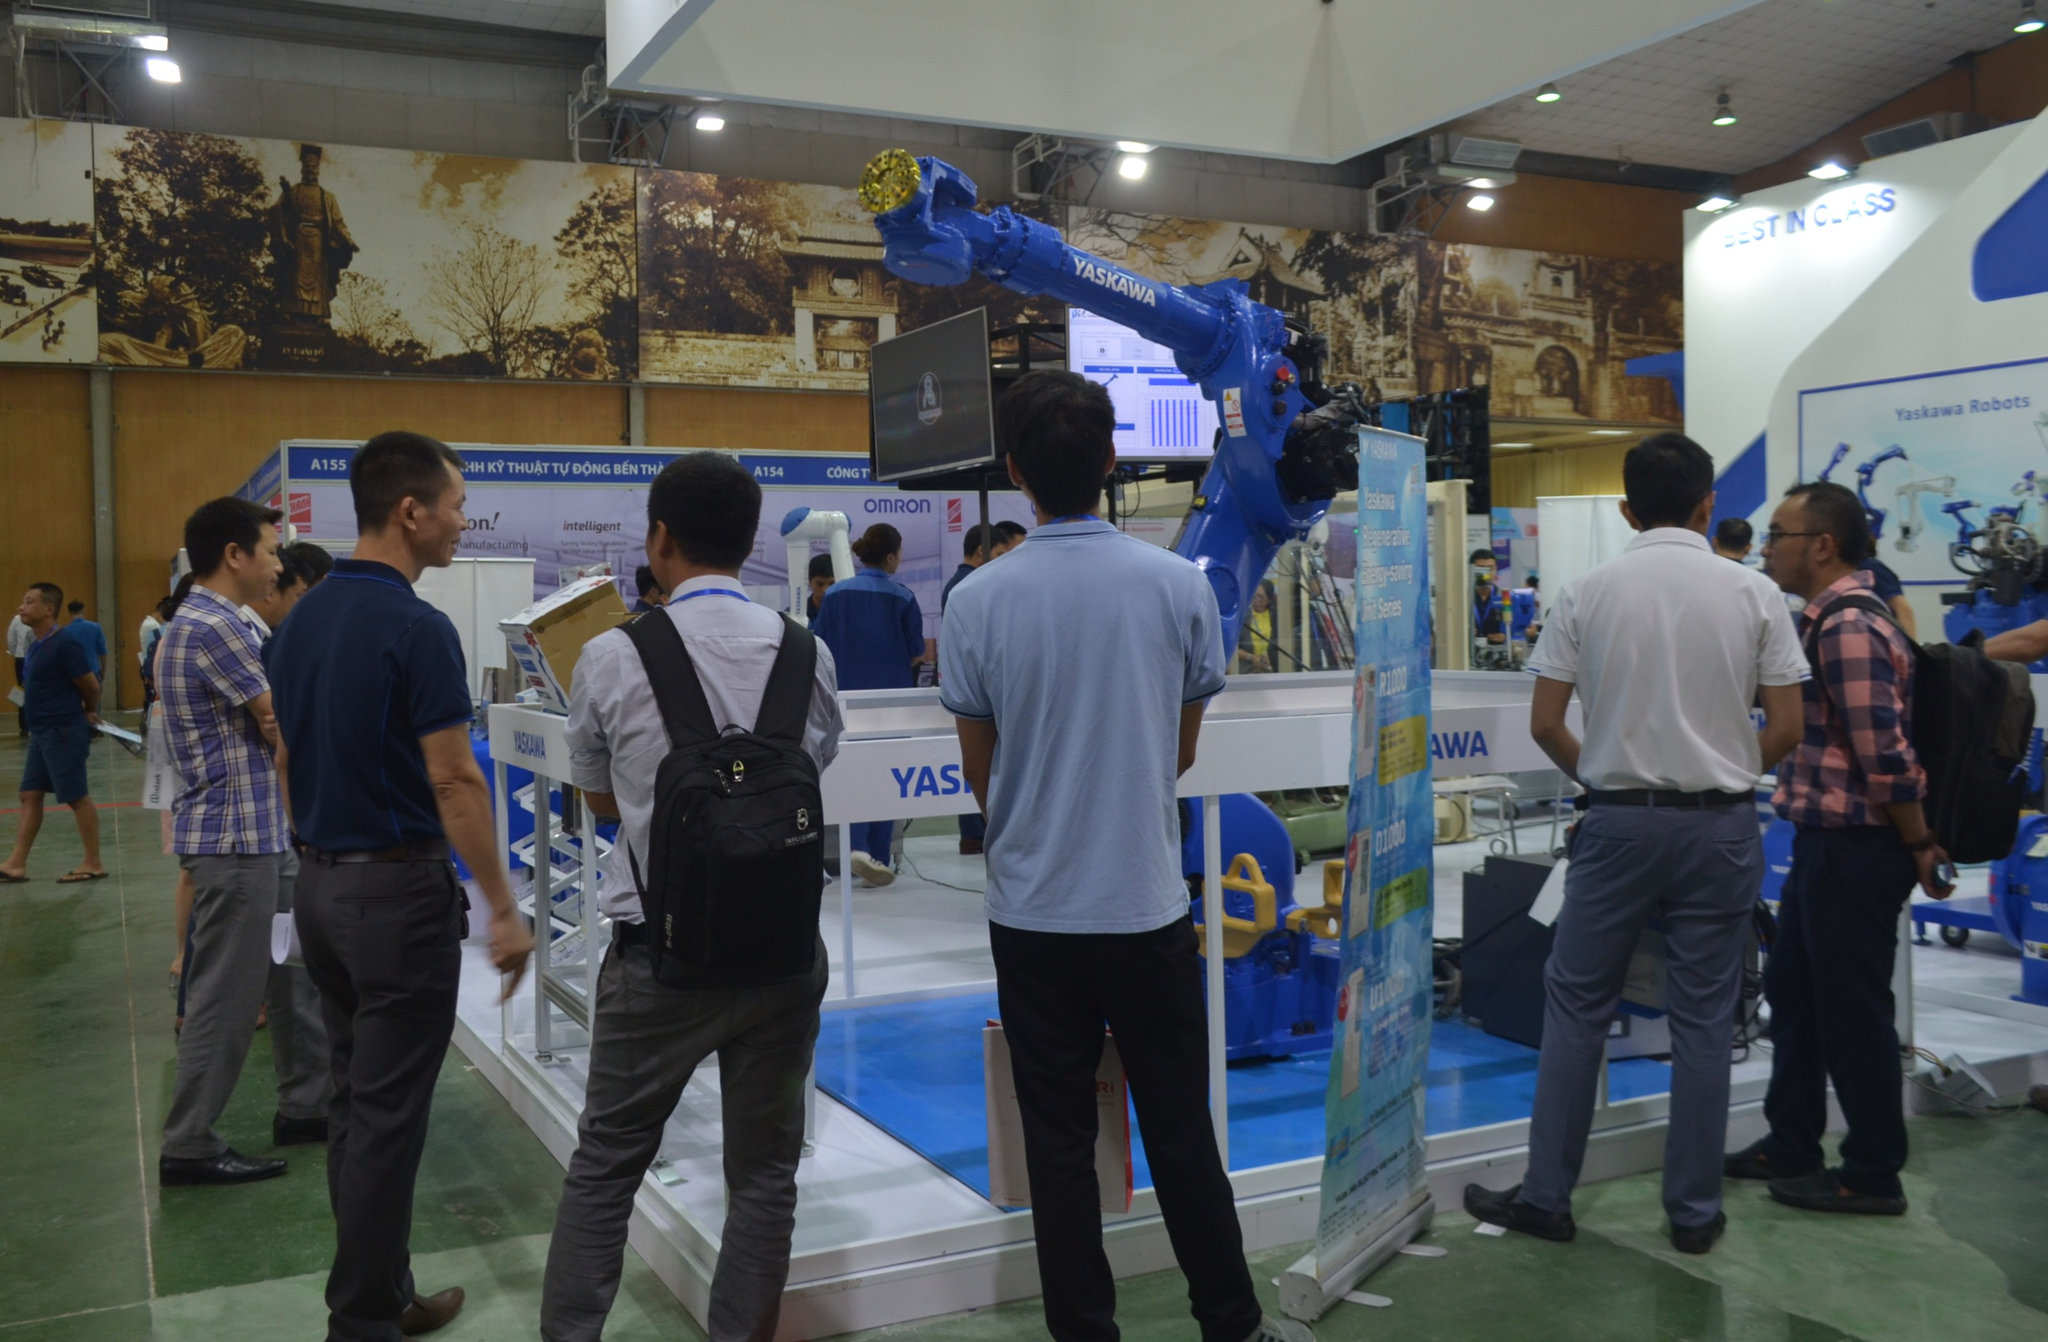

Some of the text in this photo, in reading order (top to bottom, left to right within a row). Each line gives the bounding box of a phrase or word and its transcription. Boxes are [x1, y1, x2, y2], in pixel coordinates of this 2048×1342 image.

[1073, 256, 1156, 307] YASKAWA
[1895, 396, 2031, 421] Yaskawa Robots
[310, 458, 347, 471] A155
[507, 460, 550, 476] THUẬT
[552, 461, 570, 477] TỰ
[572, 461, 611, 477] ĐỘNG
[613, 459, 638, 475] BẾN
[754, 466, 784, 477] A154
[826, 465, 860, 479] CÔNG
[863, 498, 931, 514] OMRON
[1364, 486, 1395, 510] Yaskawa
[563, 520, 621, 534] intelligent
[1362, 524, 1410, 552] Regenerative
[1361, 560, 1412, 588] Energy-saving
[1378, 595, 1402, 619] Series
[1379, 666, 1407, 697] R1000
[513, 730, 547, 760] YASKAWA
[1369, 968, 1405, 1012] U1000
